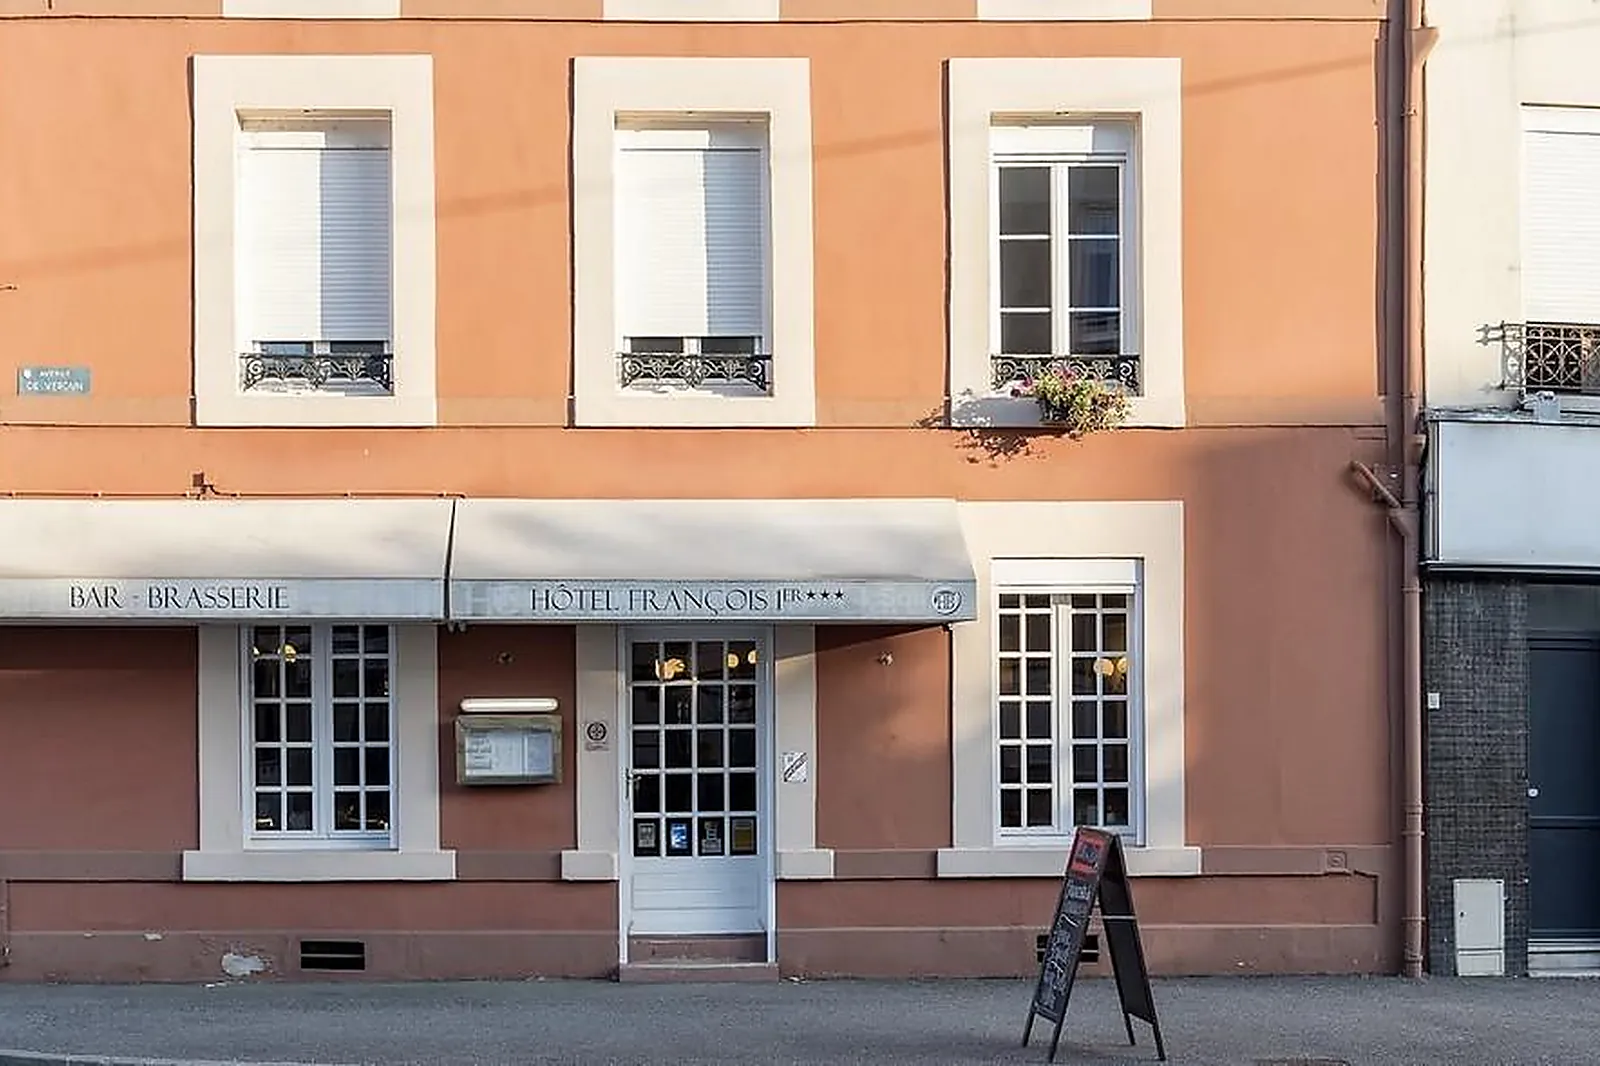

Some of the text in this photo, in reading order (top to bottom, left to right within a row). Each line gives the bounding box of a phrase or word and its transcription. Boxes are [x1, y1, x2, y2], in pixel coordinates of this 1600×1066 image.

[70, 586, 122, 609] BAR
[148, 586, 290, 609] BRASSERIE
[531, 583, 620, 611] HÔTEL
[629, 588, 769, 616] FRANÇOIS
